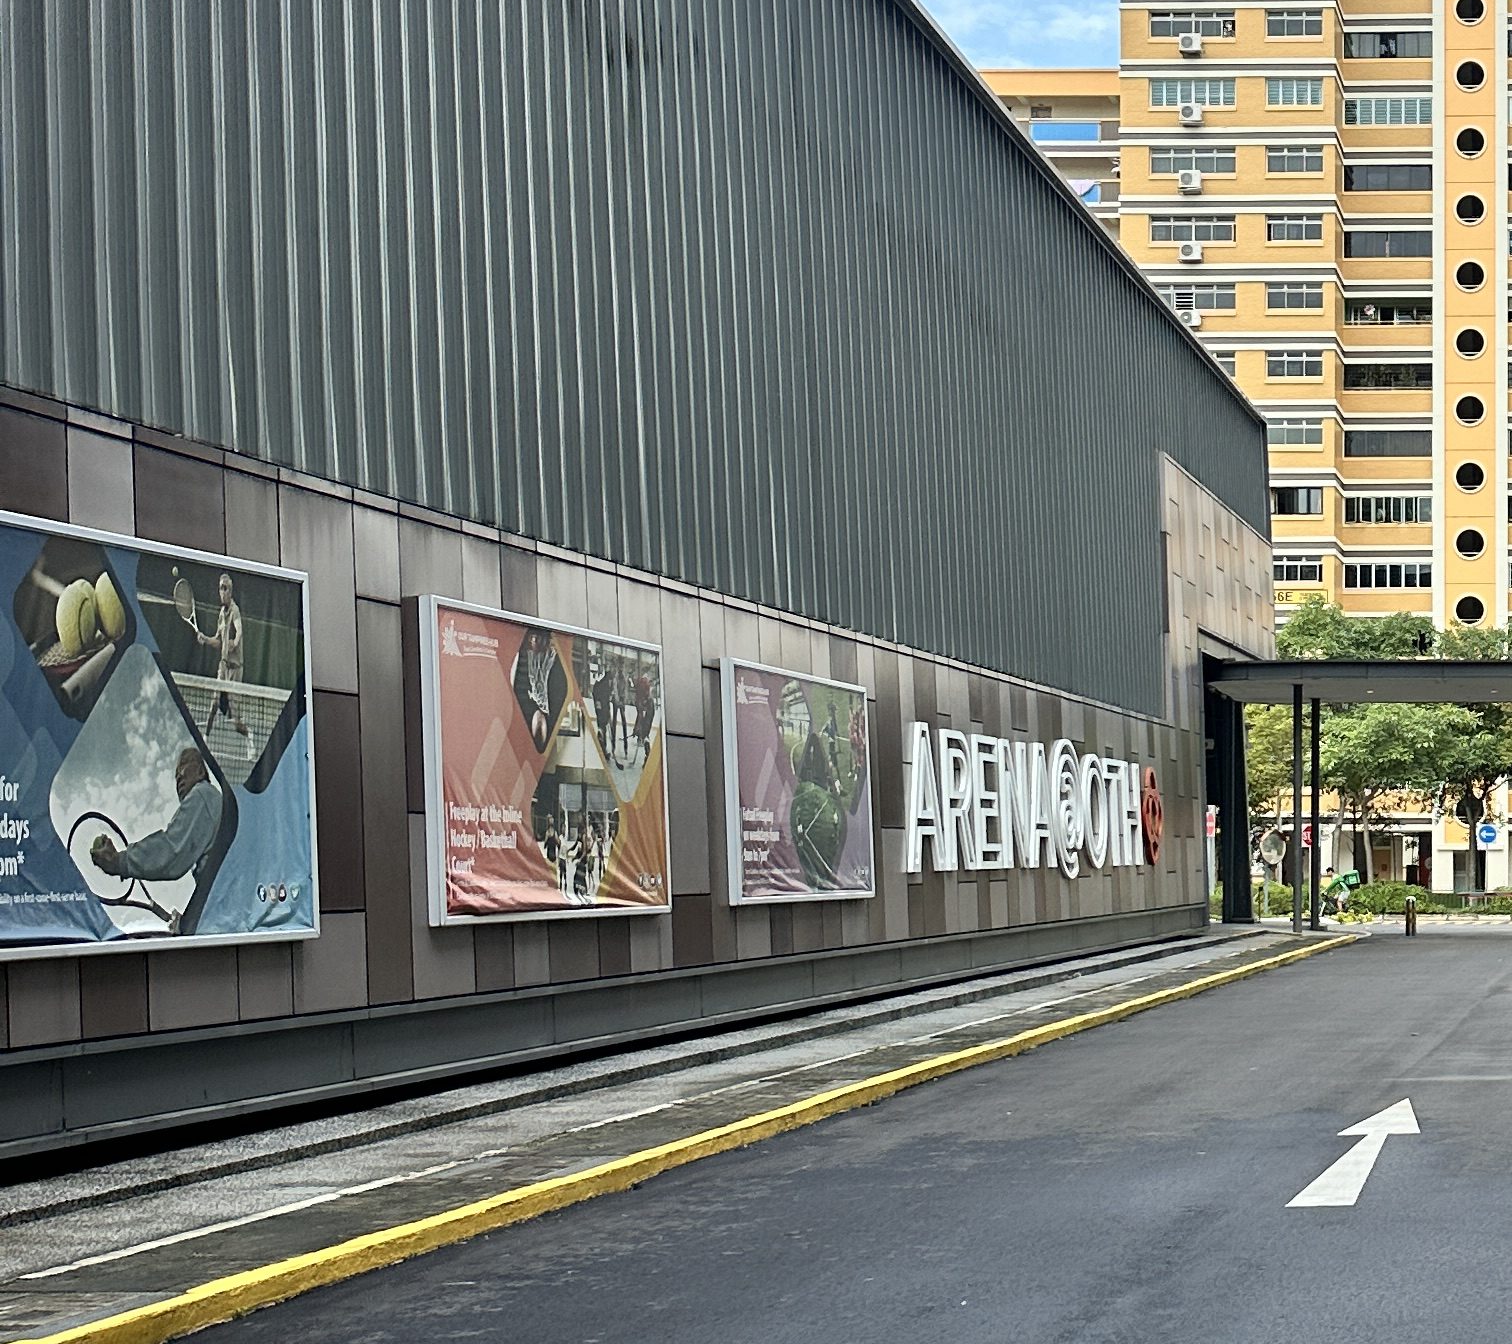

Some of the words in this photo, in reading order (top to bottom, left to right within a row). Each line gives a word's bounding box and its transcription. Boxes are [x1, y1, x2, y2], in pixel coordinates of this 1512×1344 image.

[0, 775, 20, 802] for
[449, 801, 479, 827] Freeplay
[481, 804, 490, 821] at
